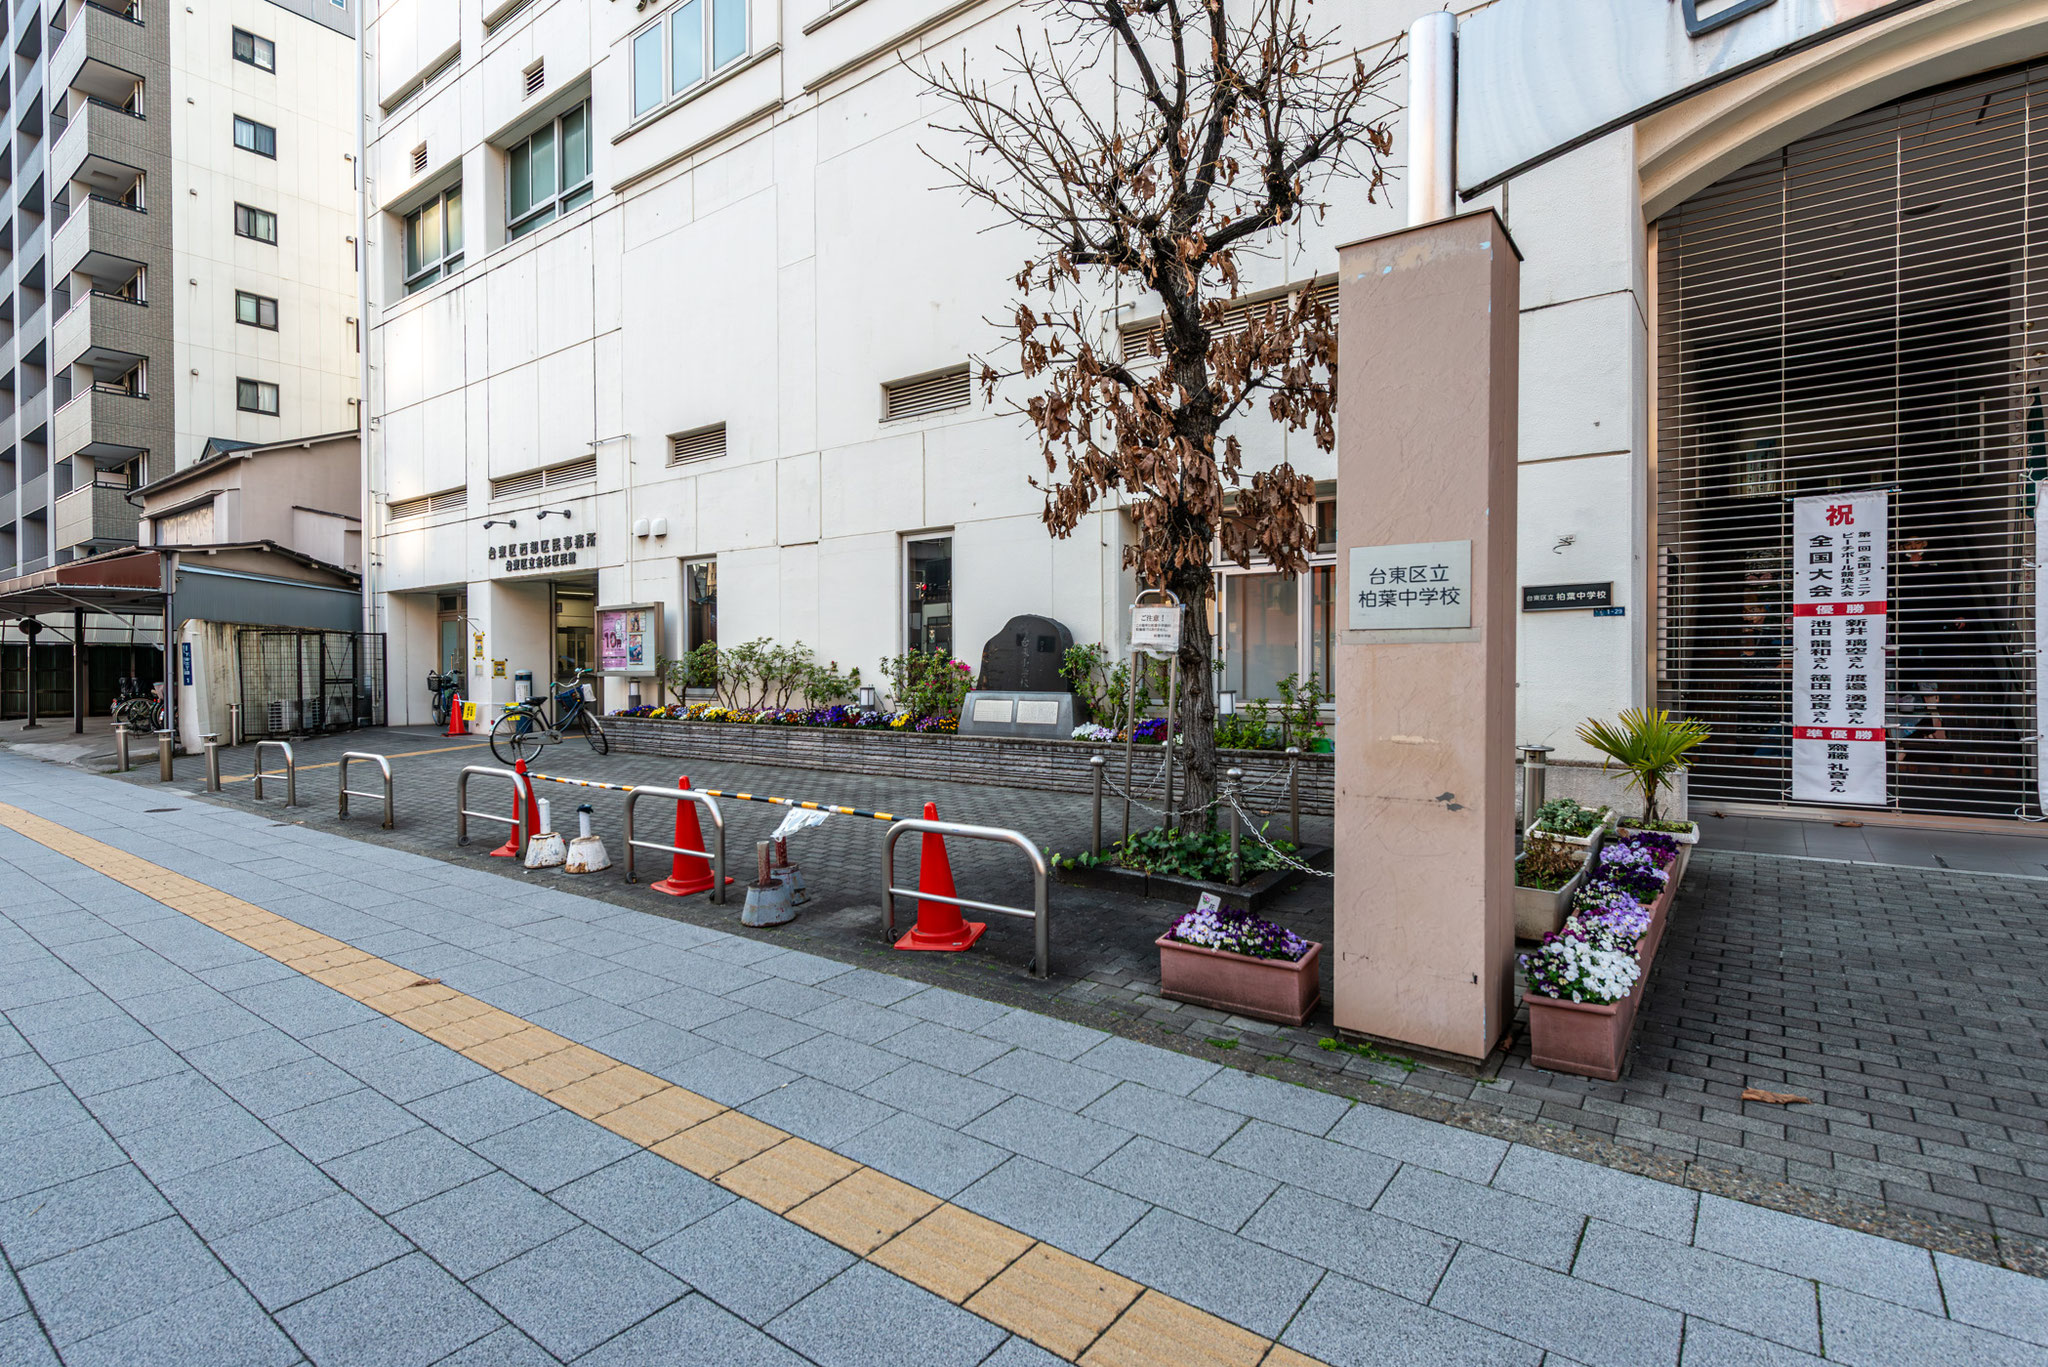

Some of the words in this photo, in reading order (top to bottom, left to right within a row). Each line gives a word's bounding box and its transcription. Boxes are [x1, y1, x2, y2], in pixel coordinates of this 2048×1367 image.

[1826, 504, 1854, 526] 祝
[488, 532, 596, 560] 台東区西部区民事務所
[1858, 531, 1871, 552] 第一回
[1369, 564, 1450, 585] 台東区立
[1809, 534, 1833, 598] 全国大会
[1841, 532, 1854, 597] ビーチボール競技大会
[1858, 555, 1871, 597] 全国ジュニア
[1359, 586, 1461, 608] 柏葉中学校
[1526, 594, 1554, 602] 台東区立
[1556, 590, 1607, 601] 柏葉中学校
[1816, 604, 1865, 615] 優勝
[1810, 619, 1832, 636] 池田
[1845, 619, 1868, 635] 新井
[1806, 728, 1873, 740] 準優勝
